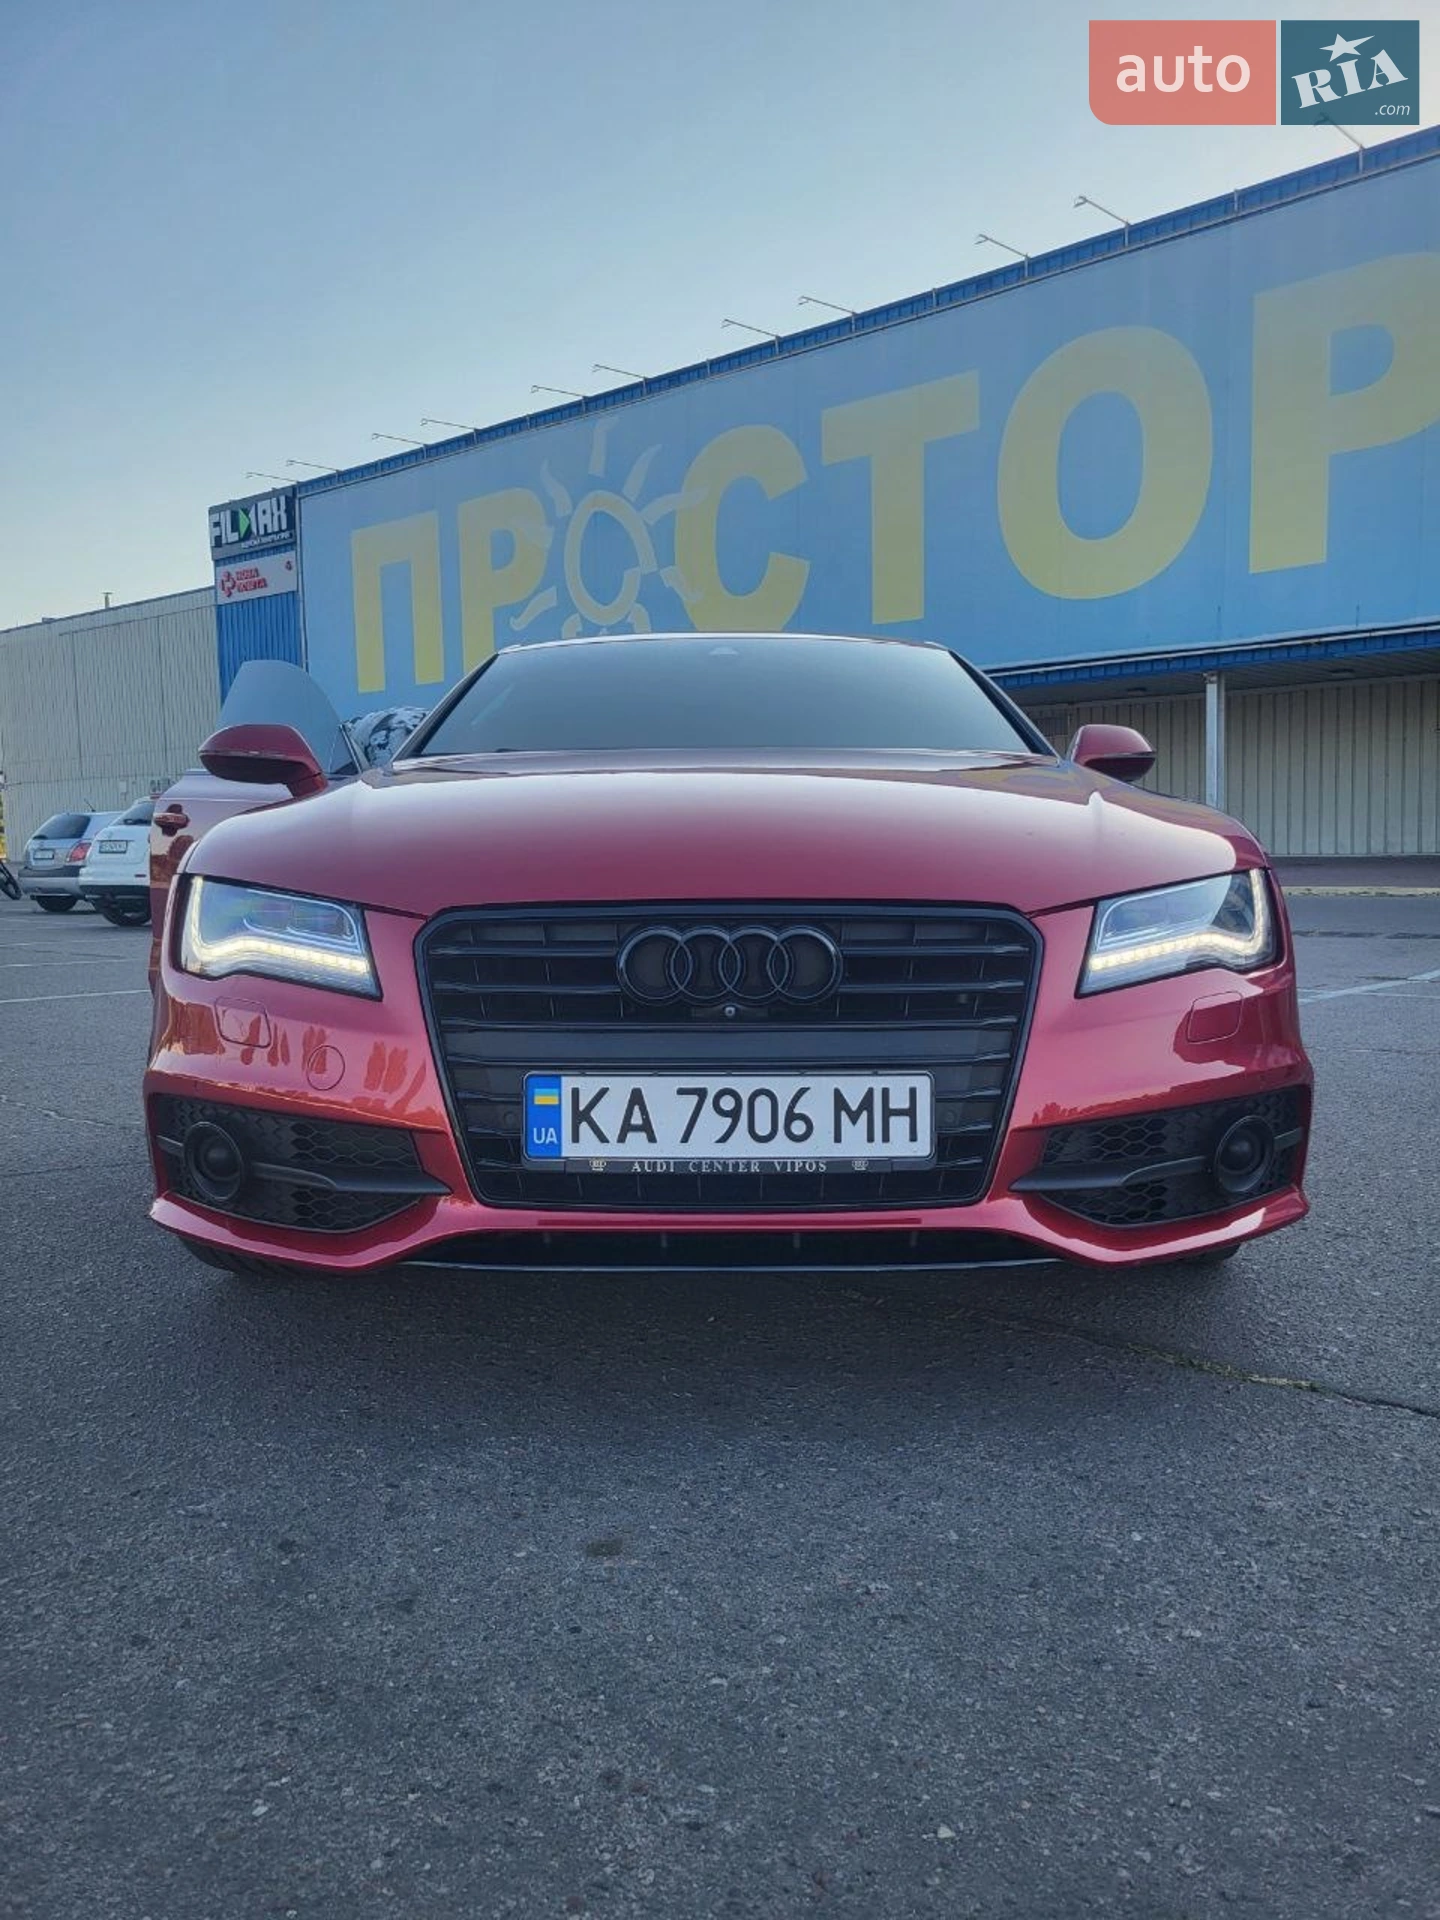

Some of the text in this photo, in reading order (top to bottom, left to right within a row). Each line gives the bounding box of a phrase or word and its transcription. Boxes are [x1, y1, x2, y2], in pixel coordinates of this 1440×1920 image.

[351, 252, 1440, 692] ПРОСТОР
[571, 1086, 918, 1144] KA 7906 MH
[533, 1128, 558, 1145] UA
[631, 1160, 828, 1173] AUDI CENTER VIPOS
